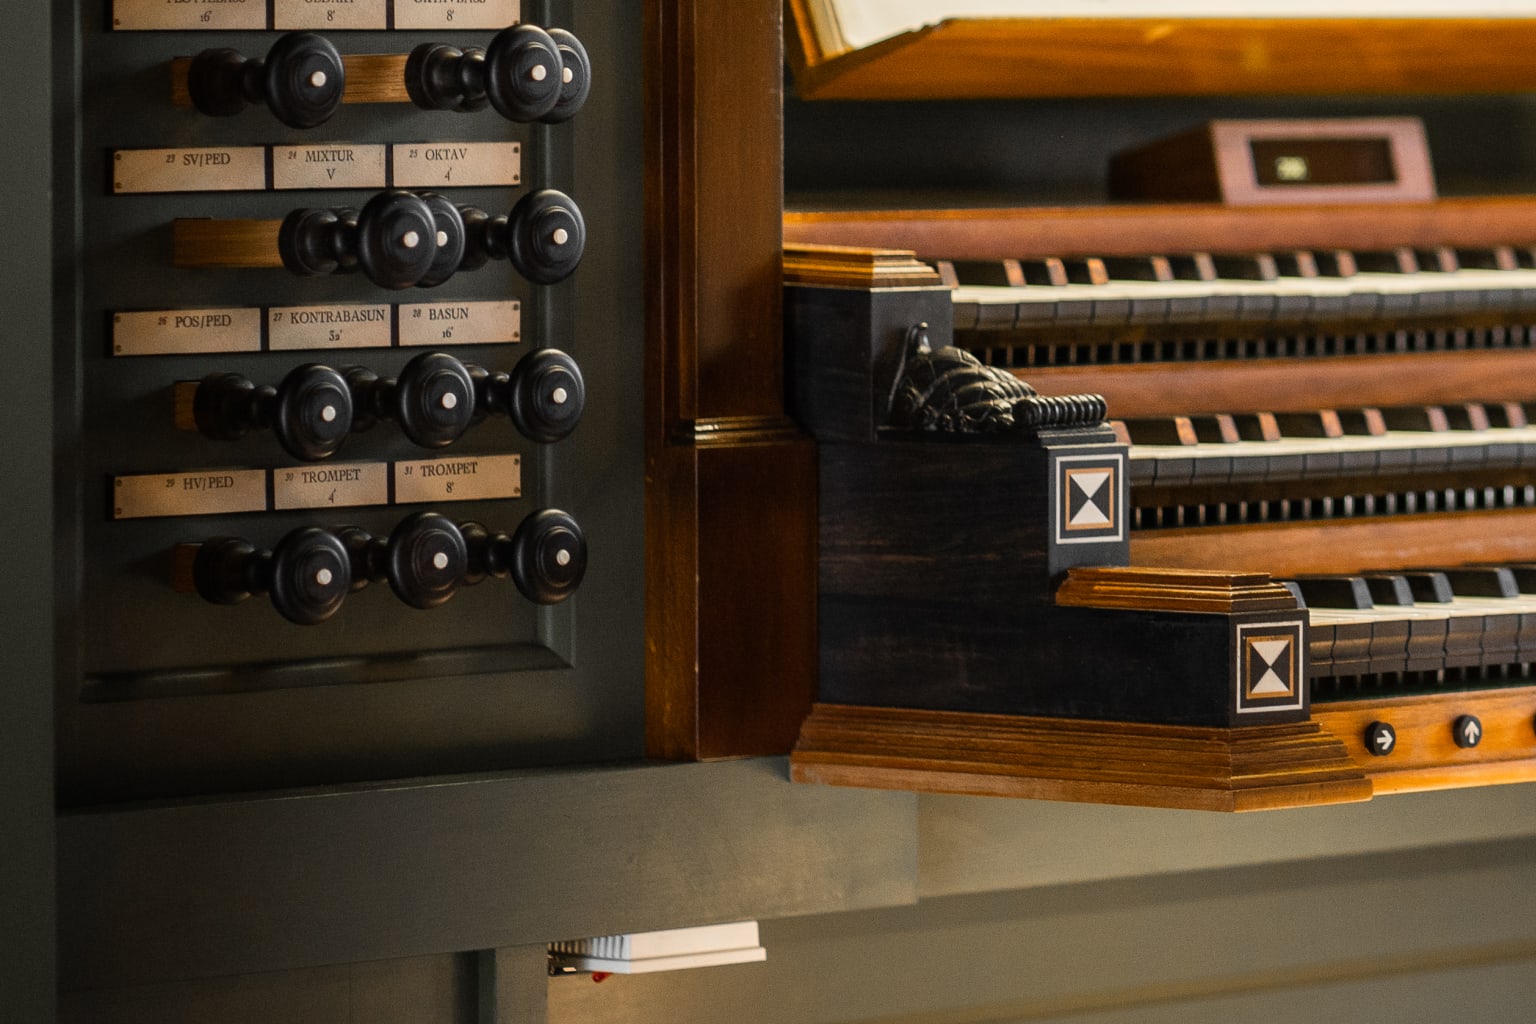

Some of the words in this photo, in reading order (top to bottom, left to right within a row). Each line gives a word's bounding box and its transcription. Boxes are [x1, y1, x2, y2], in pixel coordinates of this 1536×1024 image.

[183, 152, 231, 167] SV/PED
[305, 149, 355, 163] MIXTUR
[409, 149, 418, 159] 25
[424, 148, 468, 162] OKTAV
[326, 168, 336, 180] V
[273, 313, 282, 322] 27
[290, 309, 386, 324] KONTRABASUN
[429, 307, 469, 320] BASUN
[175, 314, 232, 329] POS/PED
[420, 462, 478, 476] TROMPET
[182, 475, 234, 491] HV/PED
[301, 469, 361, 484] TROMPET
